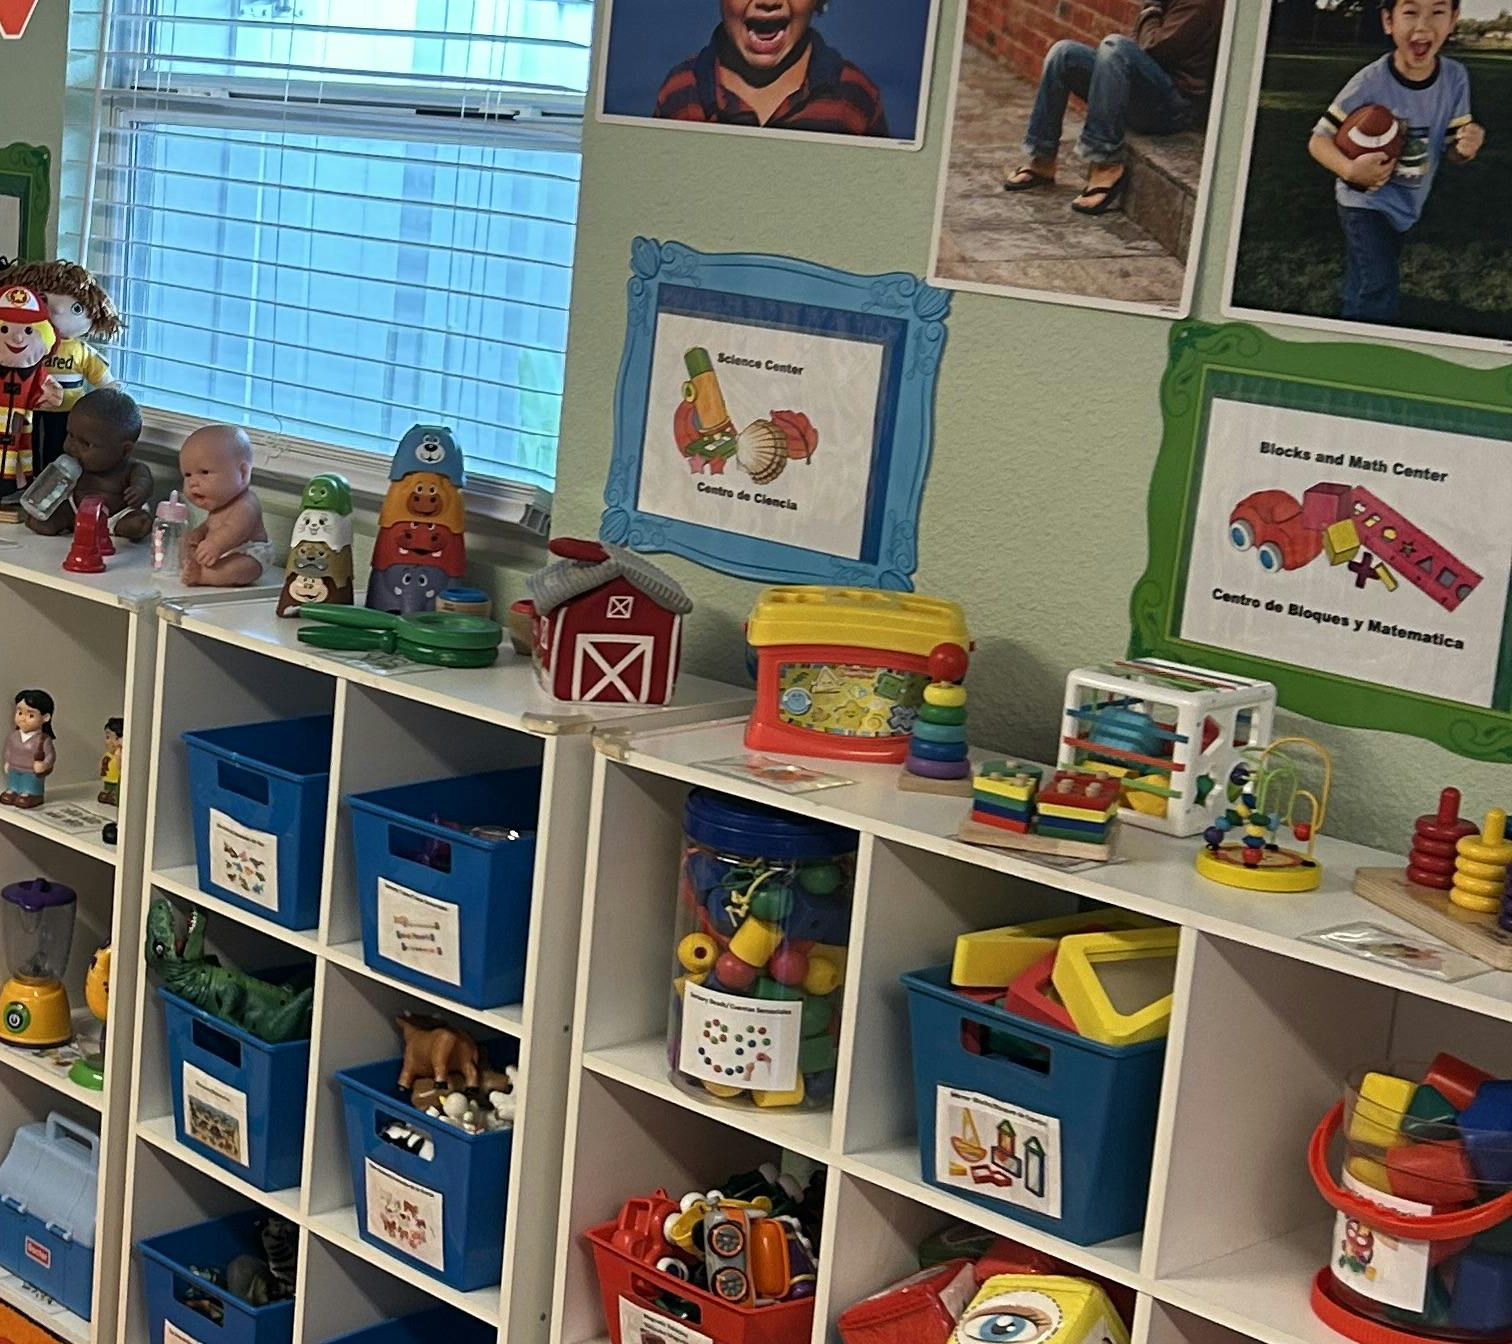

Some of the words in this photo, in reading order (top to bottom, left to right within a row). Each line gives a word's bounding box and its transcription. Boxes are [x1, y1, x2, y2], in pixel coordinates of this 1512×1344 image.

[717, 352, 762, 369] Science
[765, 360, 804, 375] Center
[1259, 441, 1312, 462] Blocks
[1315, 452, 1344, 466] and
[1349, 455, 1388, 474] Math
[1392, 463, 1448, 483] Center
[697, 482, 734, 498] Centro
[737, 490, 751, 502] de
[754, 493, 798, 510] Ciencia
[1212, 587, 1261, 609] Centro
[1265, 598, 1283, 613] de
[1288, 603, 1351, 628] Bloques
[1354, 617, 1364, 633] y
[1368, 620, 1465, 650] Matematica
